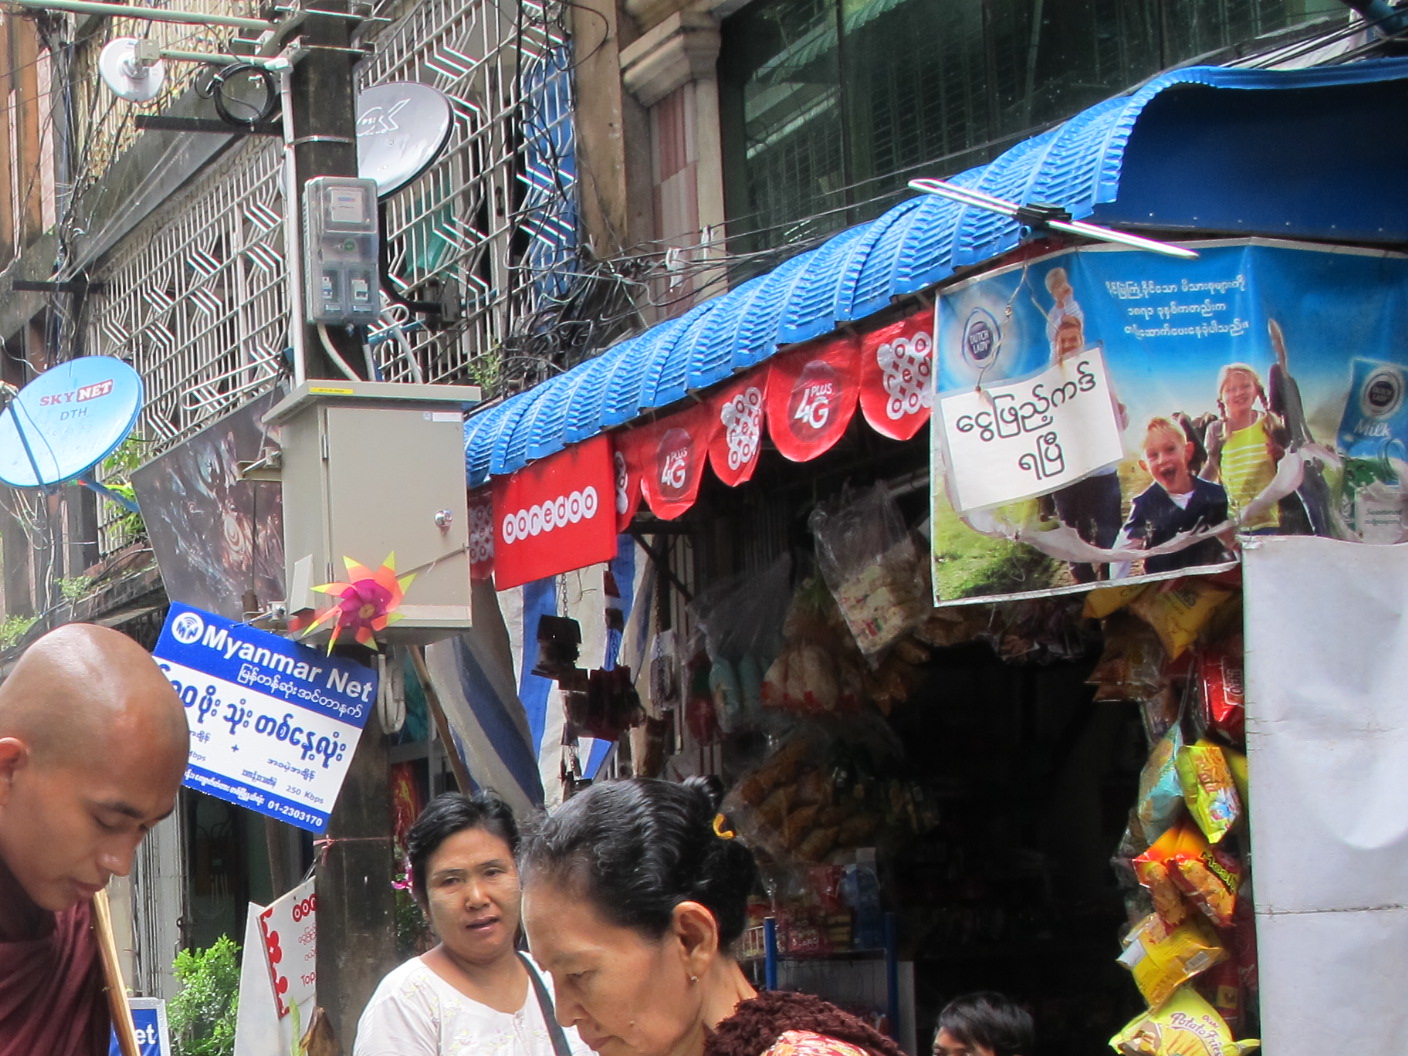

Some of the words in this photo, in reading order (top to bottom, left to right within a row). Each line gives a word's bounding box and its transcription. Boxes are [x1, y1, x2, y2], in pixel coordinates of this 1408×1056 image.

[969, 330, 990, 344] DUTCH
[972, 341, 989, 354] LADY
[810, 383, 833, 398] PLUS
[60, 407, 88, 421] DTH
[794, 388, 830, 429] 4G
[1354, 419, 1392, 440] Milk
[1018, 430, 1066, 480] ရပြီ
[661, 455, 686, 489] 4G
[504, 488, 596, 542] ooredoo
[202, 625, 323, 684] Myanmar
[326, 667, 373, 703] Net
[286, 784, 302, 797] 250
[304, 790, 324, 805] Kbps
[267, 800, 324, 828] 01-2303170
[1170, 1012, 1206, 1035] Potato
